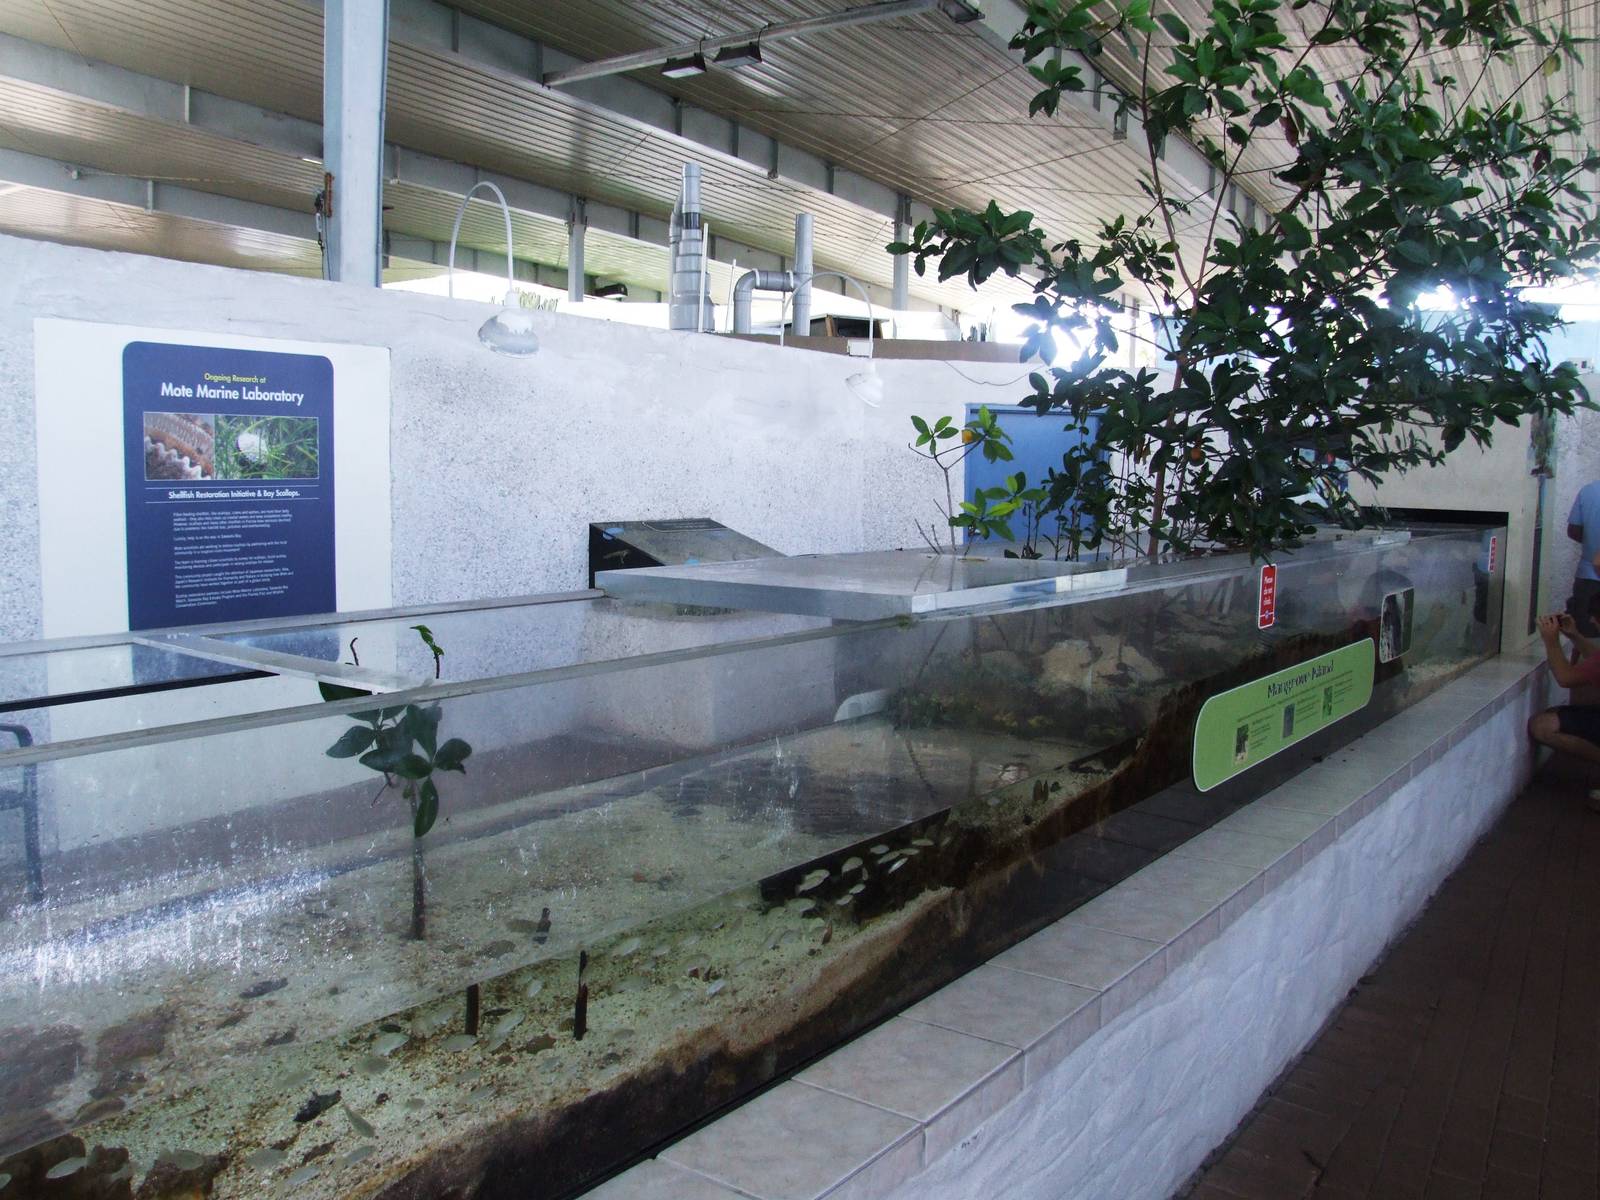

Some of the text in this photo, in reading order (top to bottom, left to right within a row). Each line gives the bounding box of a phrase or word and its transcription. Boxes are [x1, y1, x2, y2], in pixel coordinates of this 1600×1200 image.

[204, 373, 231, 383] Ongoing
[232, 375, 259, 383] Research
[161, 382, 304, 406] Mote Marine Laboratory
[168, 491, 195, 499] Shellfish
[195, 490, 230, 499] Restoration
[231, 490, 256, 498] Initiative
[263, 490, 275, 499] Bay
[1267, 672, 1310, 699] Mangrove
